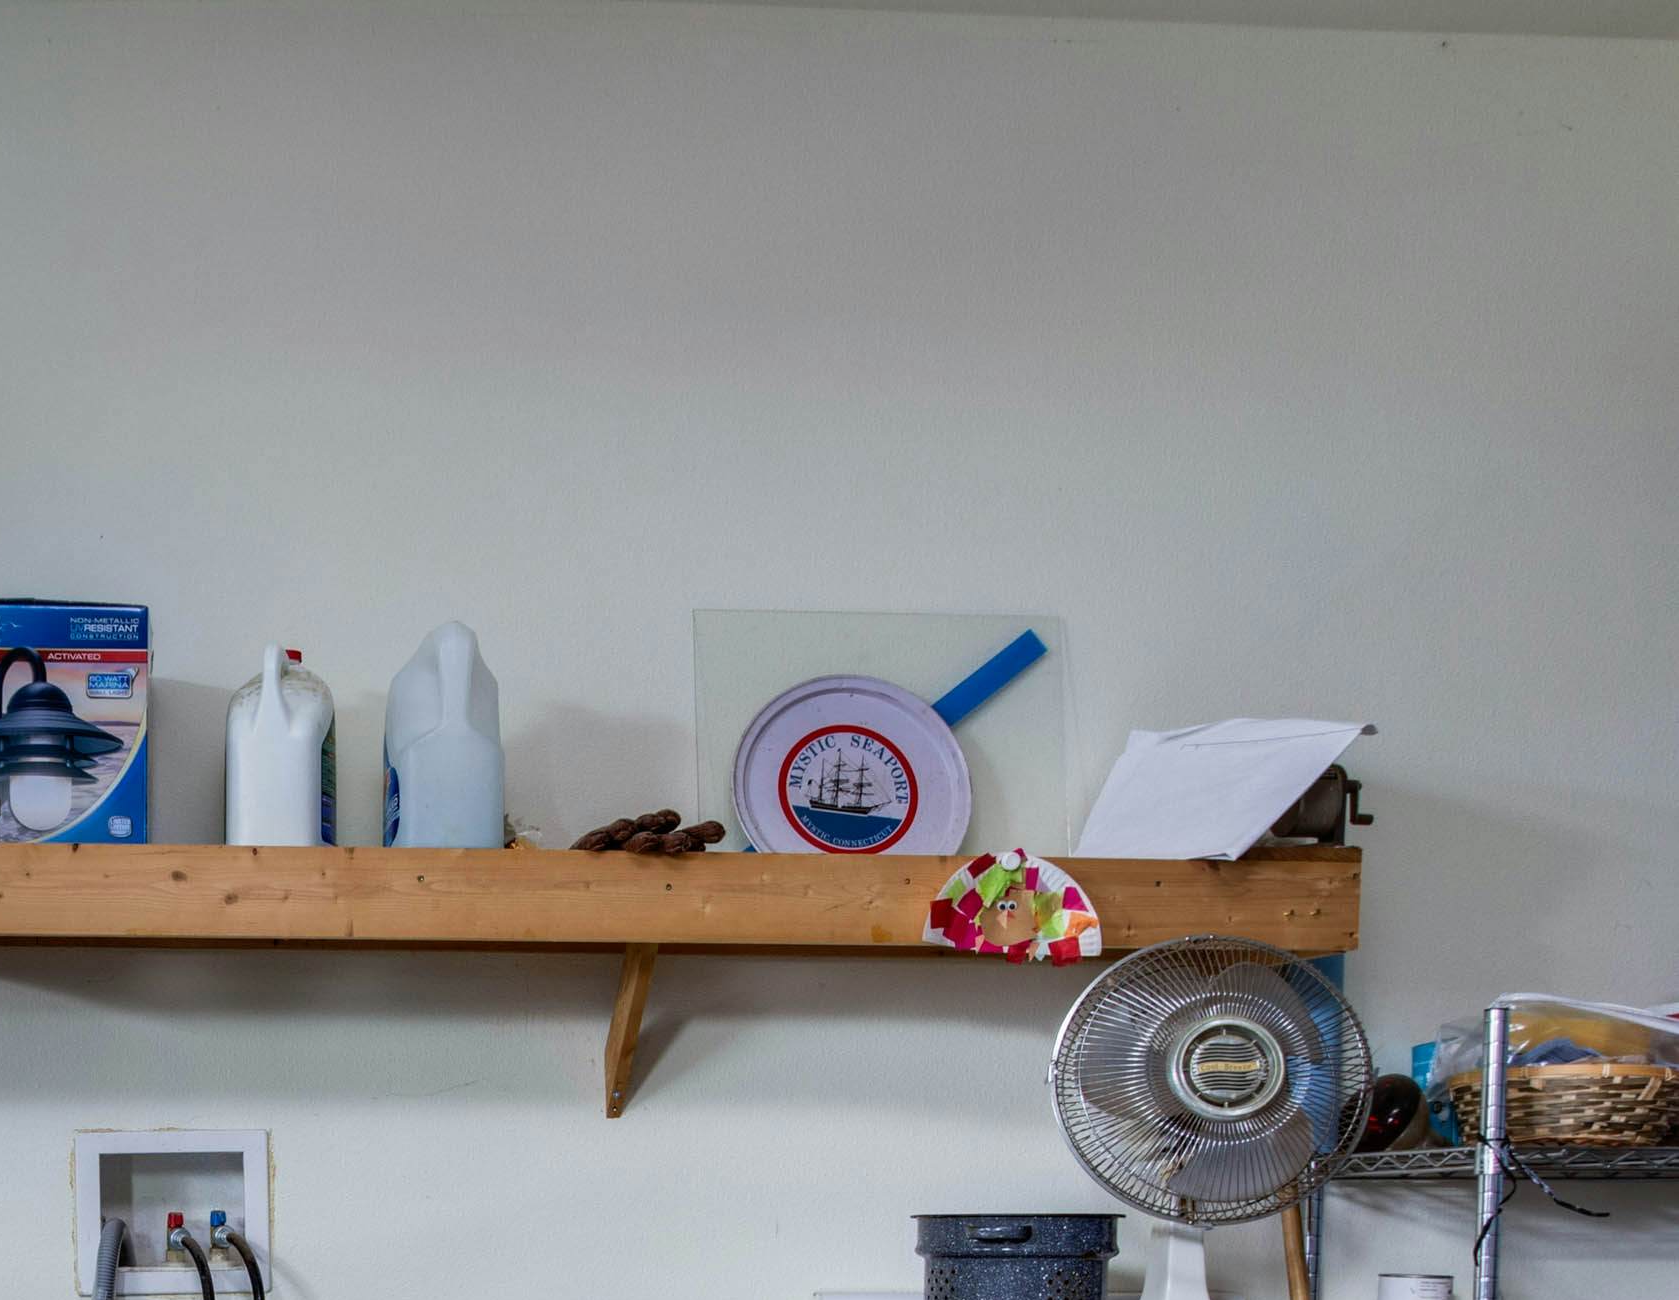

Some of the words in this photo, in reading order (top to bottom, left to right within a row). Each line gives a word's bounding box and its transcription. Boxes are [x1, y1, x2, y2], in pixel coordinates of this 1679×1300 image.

[69, 617, 140, 625] NON-METALLIC
[69, 632, 139, 640] CONSTRUCTION
[47, 652, 102, 661] ACTIVATED
[88, 681, 130, 689] MARINA
[789, 735, 836, 790] MYSTIC
[850, 735, 909, 804] SEAPORT
[832, 825, 893, 848] CONNECTICUT
